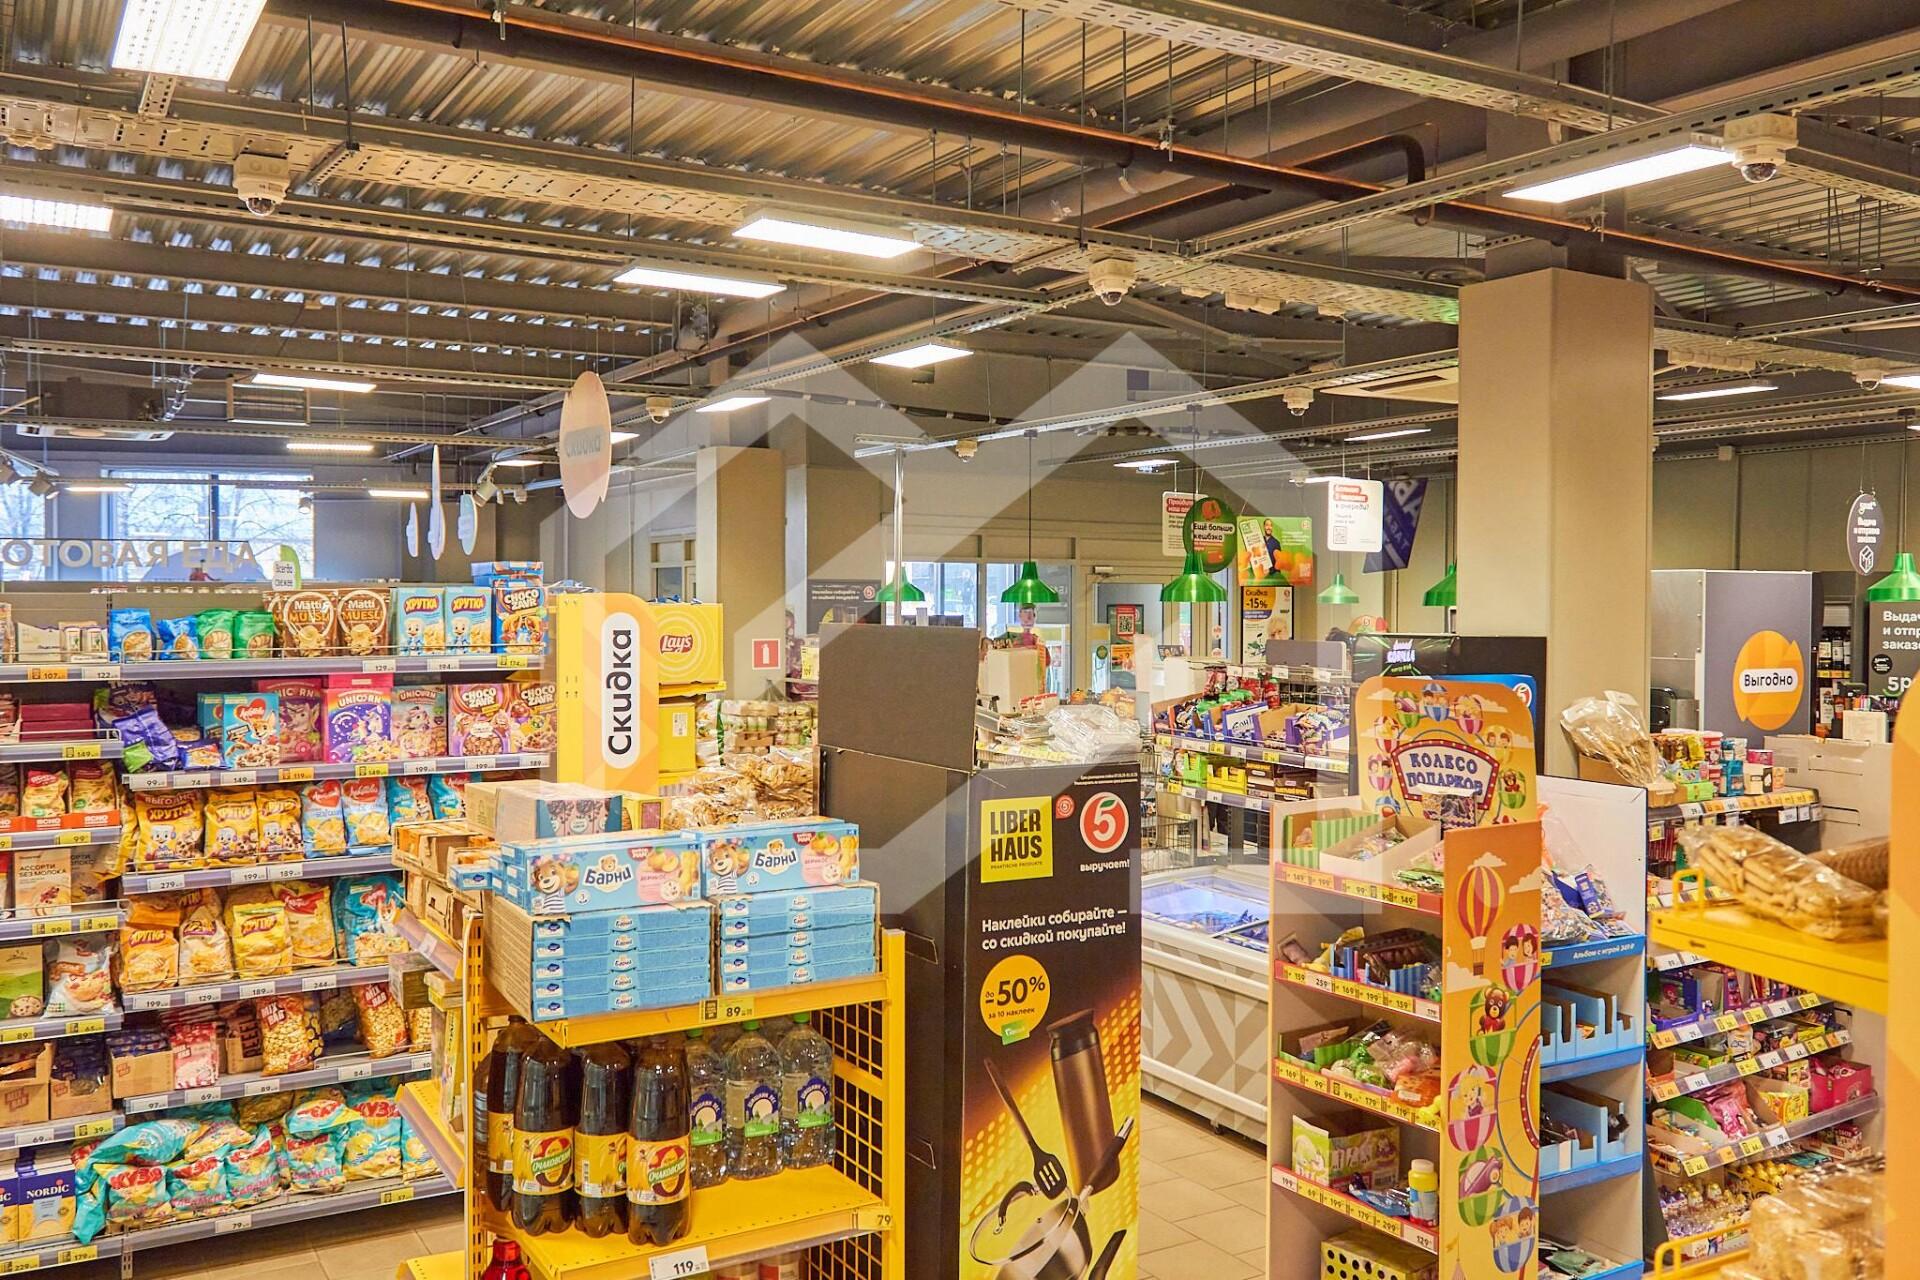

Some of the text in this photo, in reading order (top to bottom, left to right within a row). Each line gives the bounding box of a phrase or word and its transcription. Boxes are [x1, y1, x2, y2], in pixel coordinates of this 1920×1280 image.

[1208, 524, 1233, 533] больше
[183, 541, 257, 573] ЕДА
[405, 596, 438, 611] ХРУТКА
[451, 597, 485, 611] ХРУТКА
[504, 590, 539, 605] CHOCO
[1246, 598, 1268, 608] -15%
[1744, 673, 1793, 687] Выгодно
[462, 687, 496, 701] CHOCO
[521, 685, 555, 700] CHOCO
[606, 629, 632, 755] Скидка
[338, 694, 381, 706] UNICORN
[1410, 753, 1478, 772] КОЛЕСО
[990, 809, 1041, 835] LIBER
[991, 836, 1042, 862] HAUS
[754, 850, 797, 868] Барни
[1080, 859, 1130, 872] выручает!
[20, 863, 56, 871] АССОРТИ
[585, 866, 632, 886] Барни
[982, 914, 1045, 932] Наклейки
[1048, 907, 1115, 925] собирайте
[982, 922, 1126, 950] со скидкой покупайте!
[986, 991, 995, 999] до
[726, 1007, 741, 1017] 89
[26, 1184, 70, 1199] NORDIC
[877, 1214, 891, 1225] 79
[673, 1260, 694, 1275] 119
